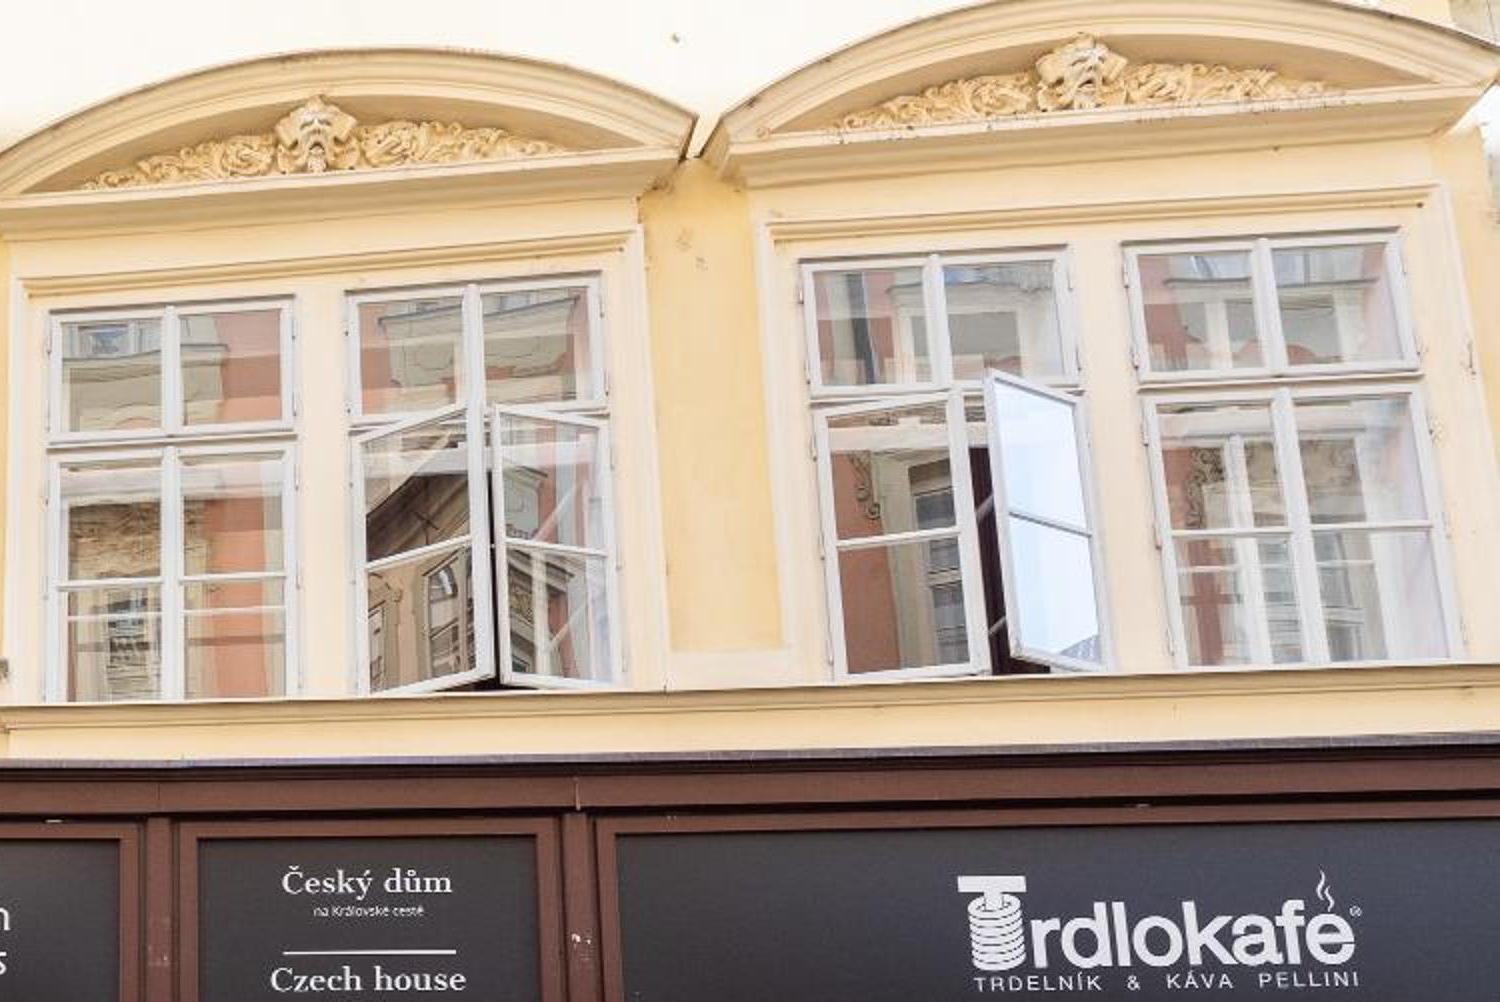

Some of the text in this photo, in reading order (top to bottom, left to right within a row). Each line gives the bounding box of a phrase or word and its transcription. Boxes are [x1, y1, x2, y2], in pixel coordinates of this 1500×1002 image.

[281, 865, 453, 901] Český dům
[313, 906, 329, 918] na
[270, 965, 467, 992] Czech house
[974, 968, 1360, 993] TRDELNÍK & KÁVA PELLINI
